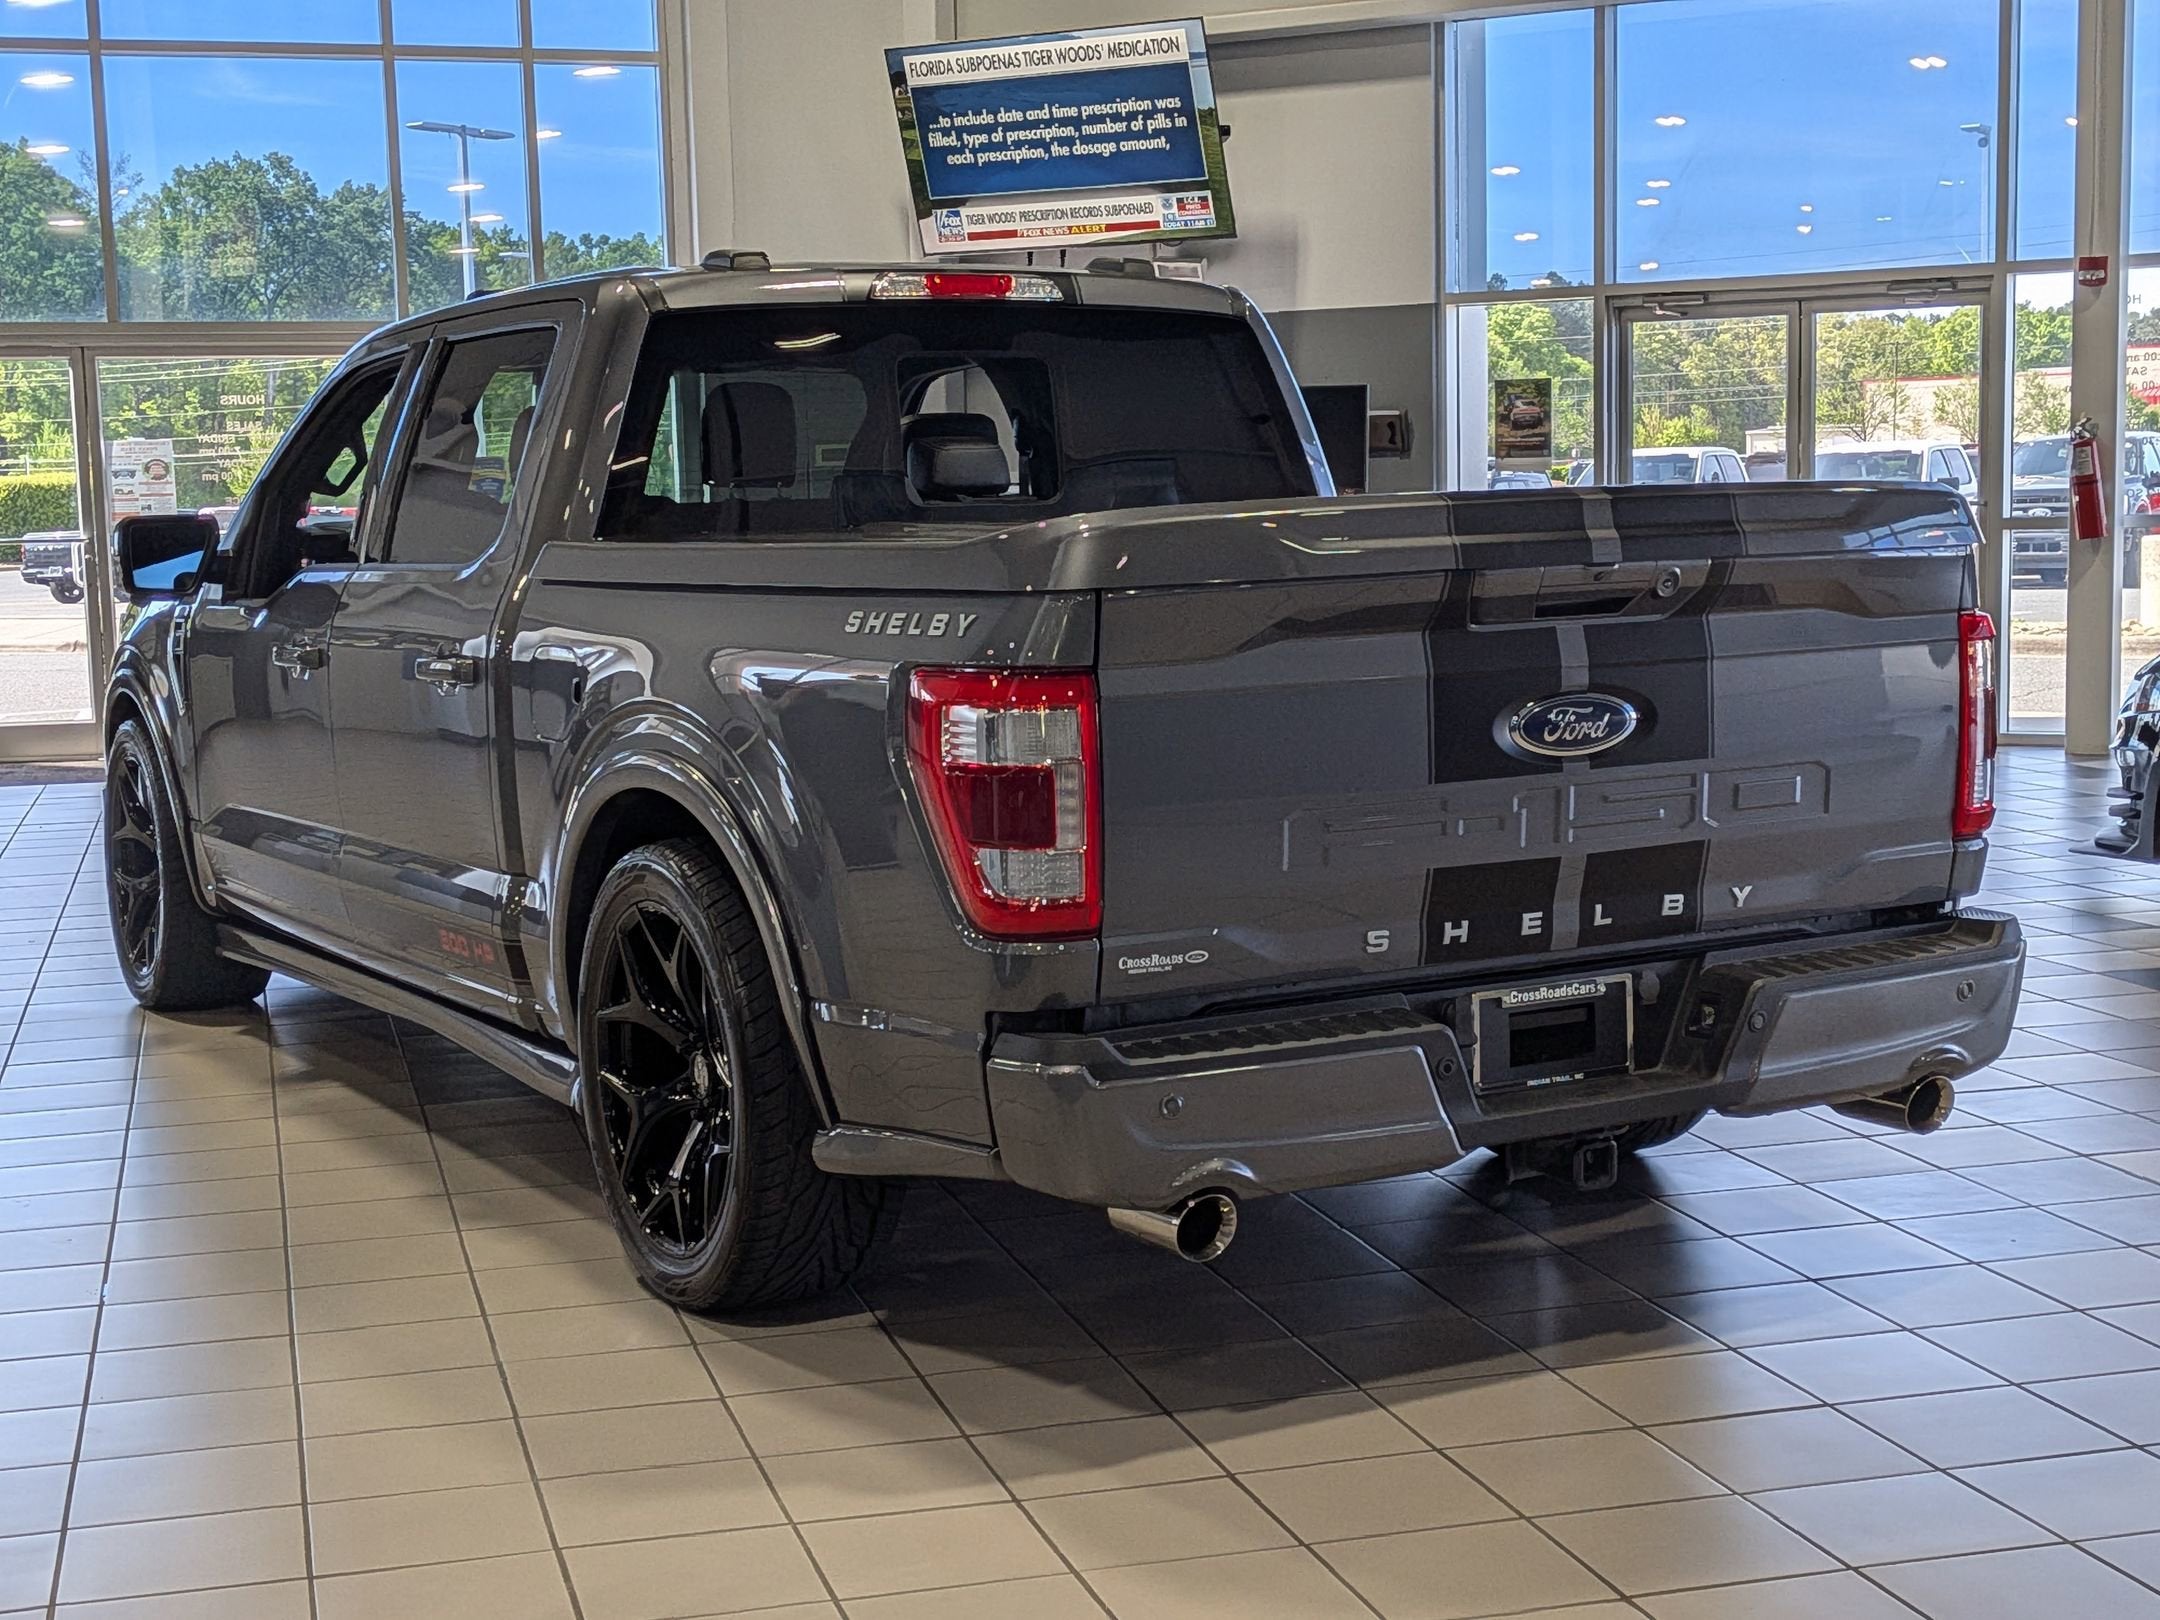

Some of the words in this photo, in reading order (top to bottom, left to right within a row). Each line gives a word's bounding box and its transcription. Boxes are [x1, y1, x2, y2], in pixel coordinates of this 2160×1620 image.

[908, 58, 955, 79] FLORIDA
[956, 52, 1021, 74] SUBPOENAS
[1021, 49, 1054, 68] TIGER
[1054, 43, 1104, 65] WOODS'
[1107, 36, 1181, 60] MEDICATION
[953, 109, 995, 127] include
[997, 106, 1024, 123] date
[1026, 103, 1050, 120] and
[1052, 103, 1078, 118] time
[1081, 97, 1153, 120] prescription
[1154, 97, 1182, 109] was
[928, 130, 961, 148] filled,
[963, 132, 989, 148] type
[991, 126, 1004, 142] of
[1006, 122, 1080, 145] prescription,
[1081, 117, 1128, 136] number
[1130, 114, 1144, 132] of
[1146, 112, 1173, 134] pills
[1174, 112, 1188, 127] in
[946, 148, 975, 165] each
[977, 144, 1049, 167] prescription,
[1050, 141, 1071, 157] the
[1072, 139, 1117, 157] dosage
[1119, 136, 1171, 151] amount,
[944, 217, 962, 227] FOX
[965, 212, 986, 226] TIGER
[1018, 207, 1069, 223] PRESCRIPTION
[1070, 205, 1103, 220] RECORDS
[1104, 201, 1154, 217] SUBPOENAED
[941, 226, 964, 236] NEWS
[1023, 228, 1042, 237] FOX
[1043, 226, 1069, 236] NEWS
[1071, 223, 1106, 234] ALERT
[844, 610, 977, 638] SHELBY
[1543, 706, 1611, 742] Ford
